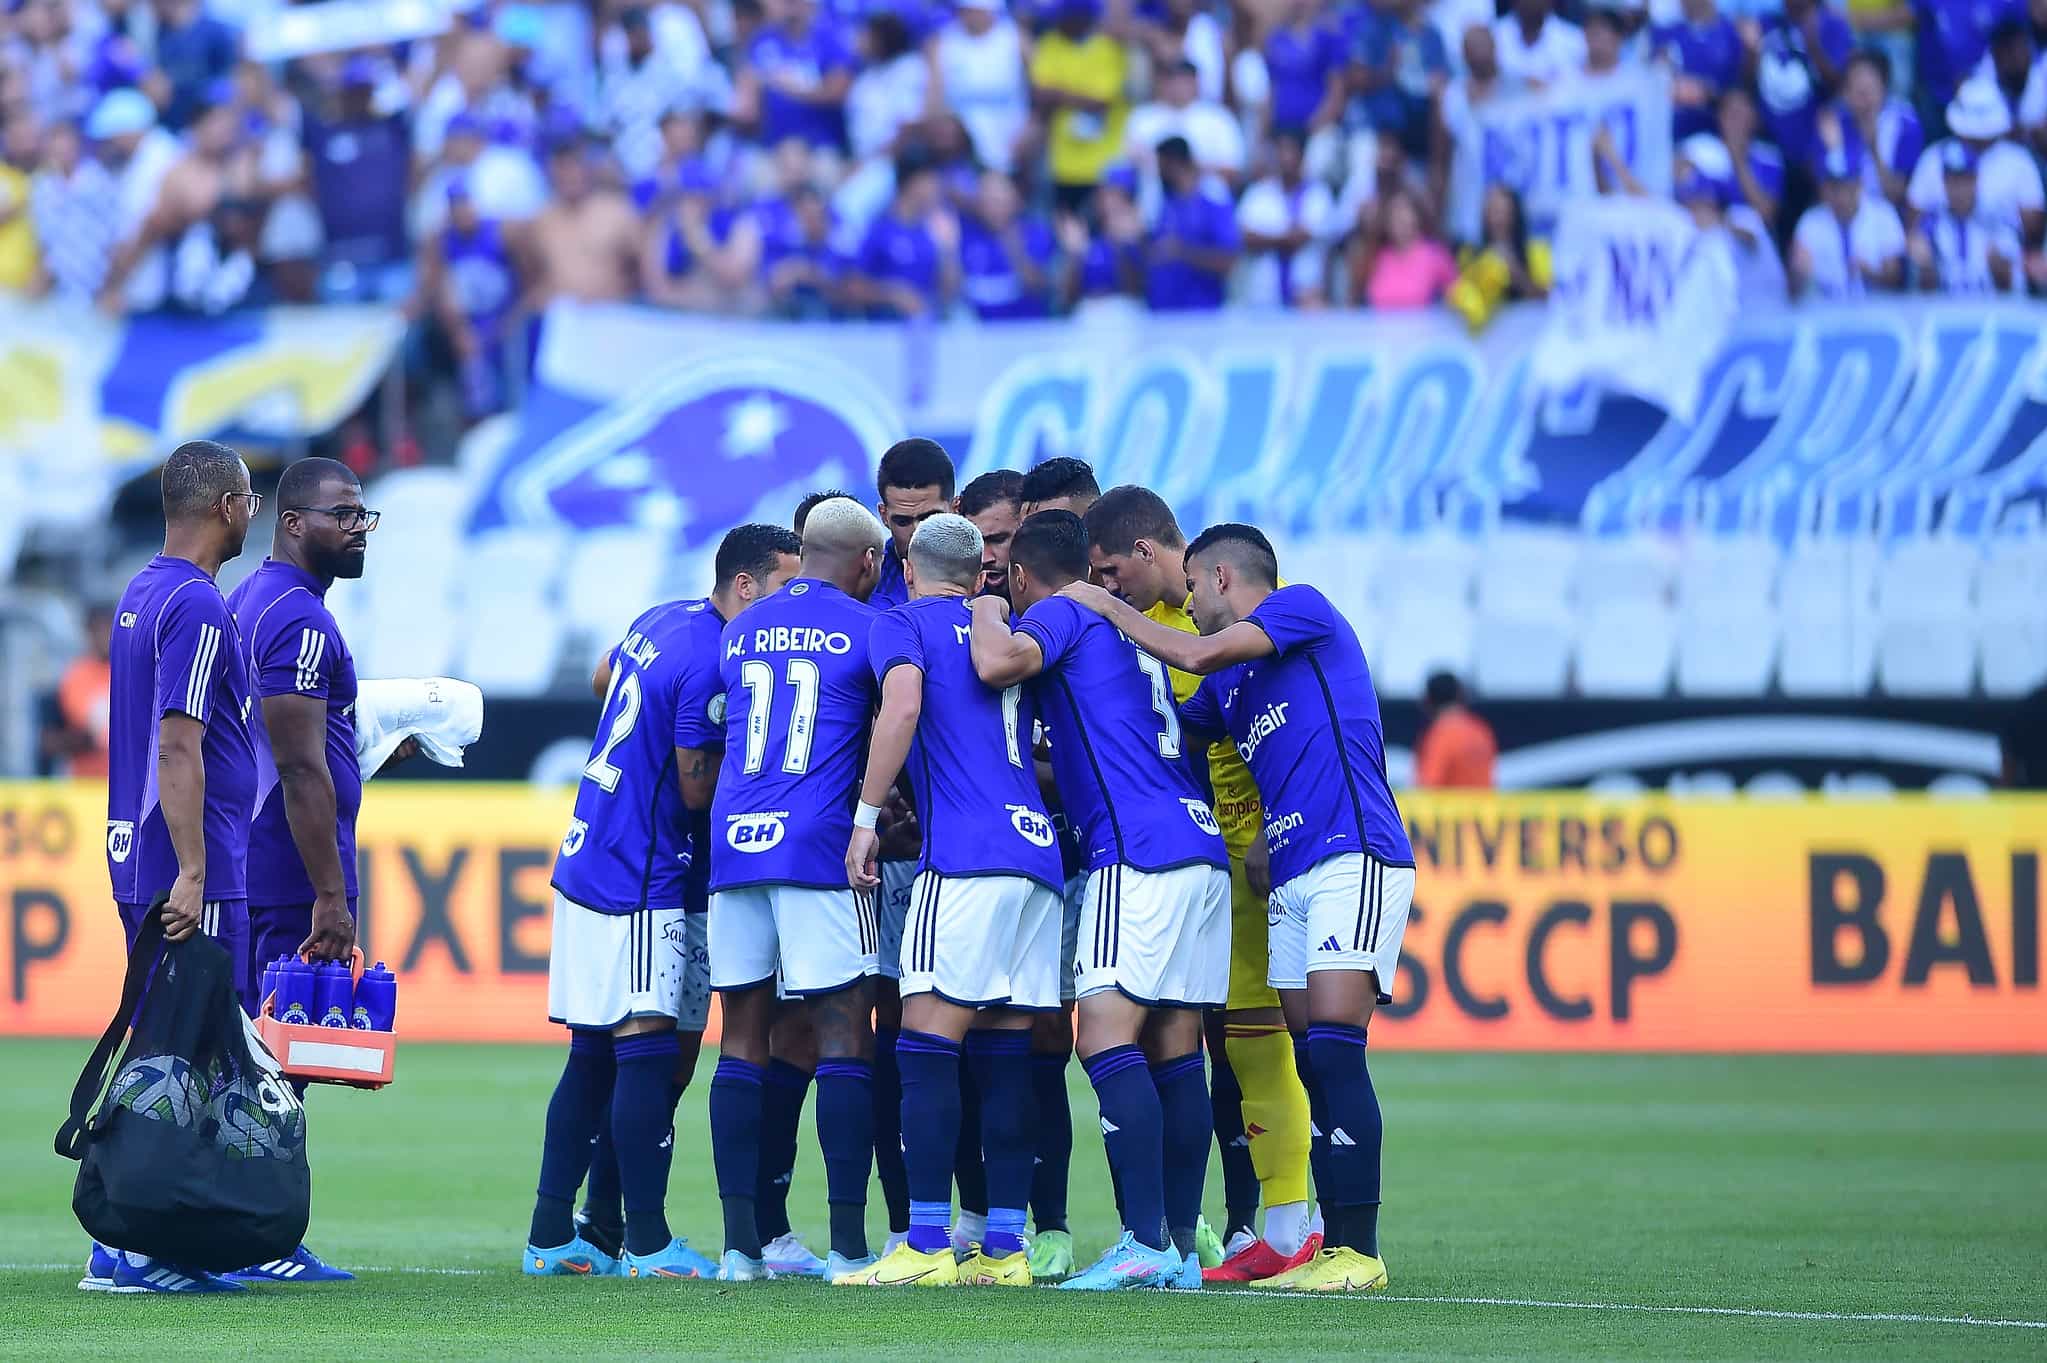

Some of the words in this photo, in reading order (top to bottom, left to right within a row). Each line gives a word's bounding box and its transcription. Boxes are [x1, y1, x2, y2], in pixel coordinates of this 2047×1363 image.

[726, 634, 746, 660] W.
[755, 627, 851, 655] RIBEIRO
[741, 658, 820, 774] 11
[1237, 701, 1289, 763] betfair
[112, 832, 131, 853] BH
[733, 823, 778, 845] BH
[1019, 816, 1049, 841] BH
[1808, 850, 2041, 988] BAI
[1374, 898, 1679, 1022] SCCP
